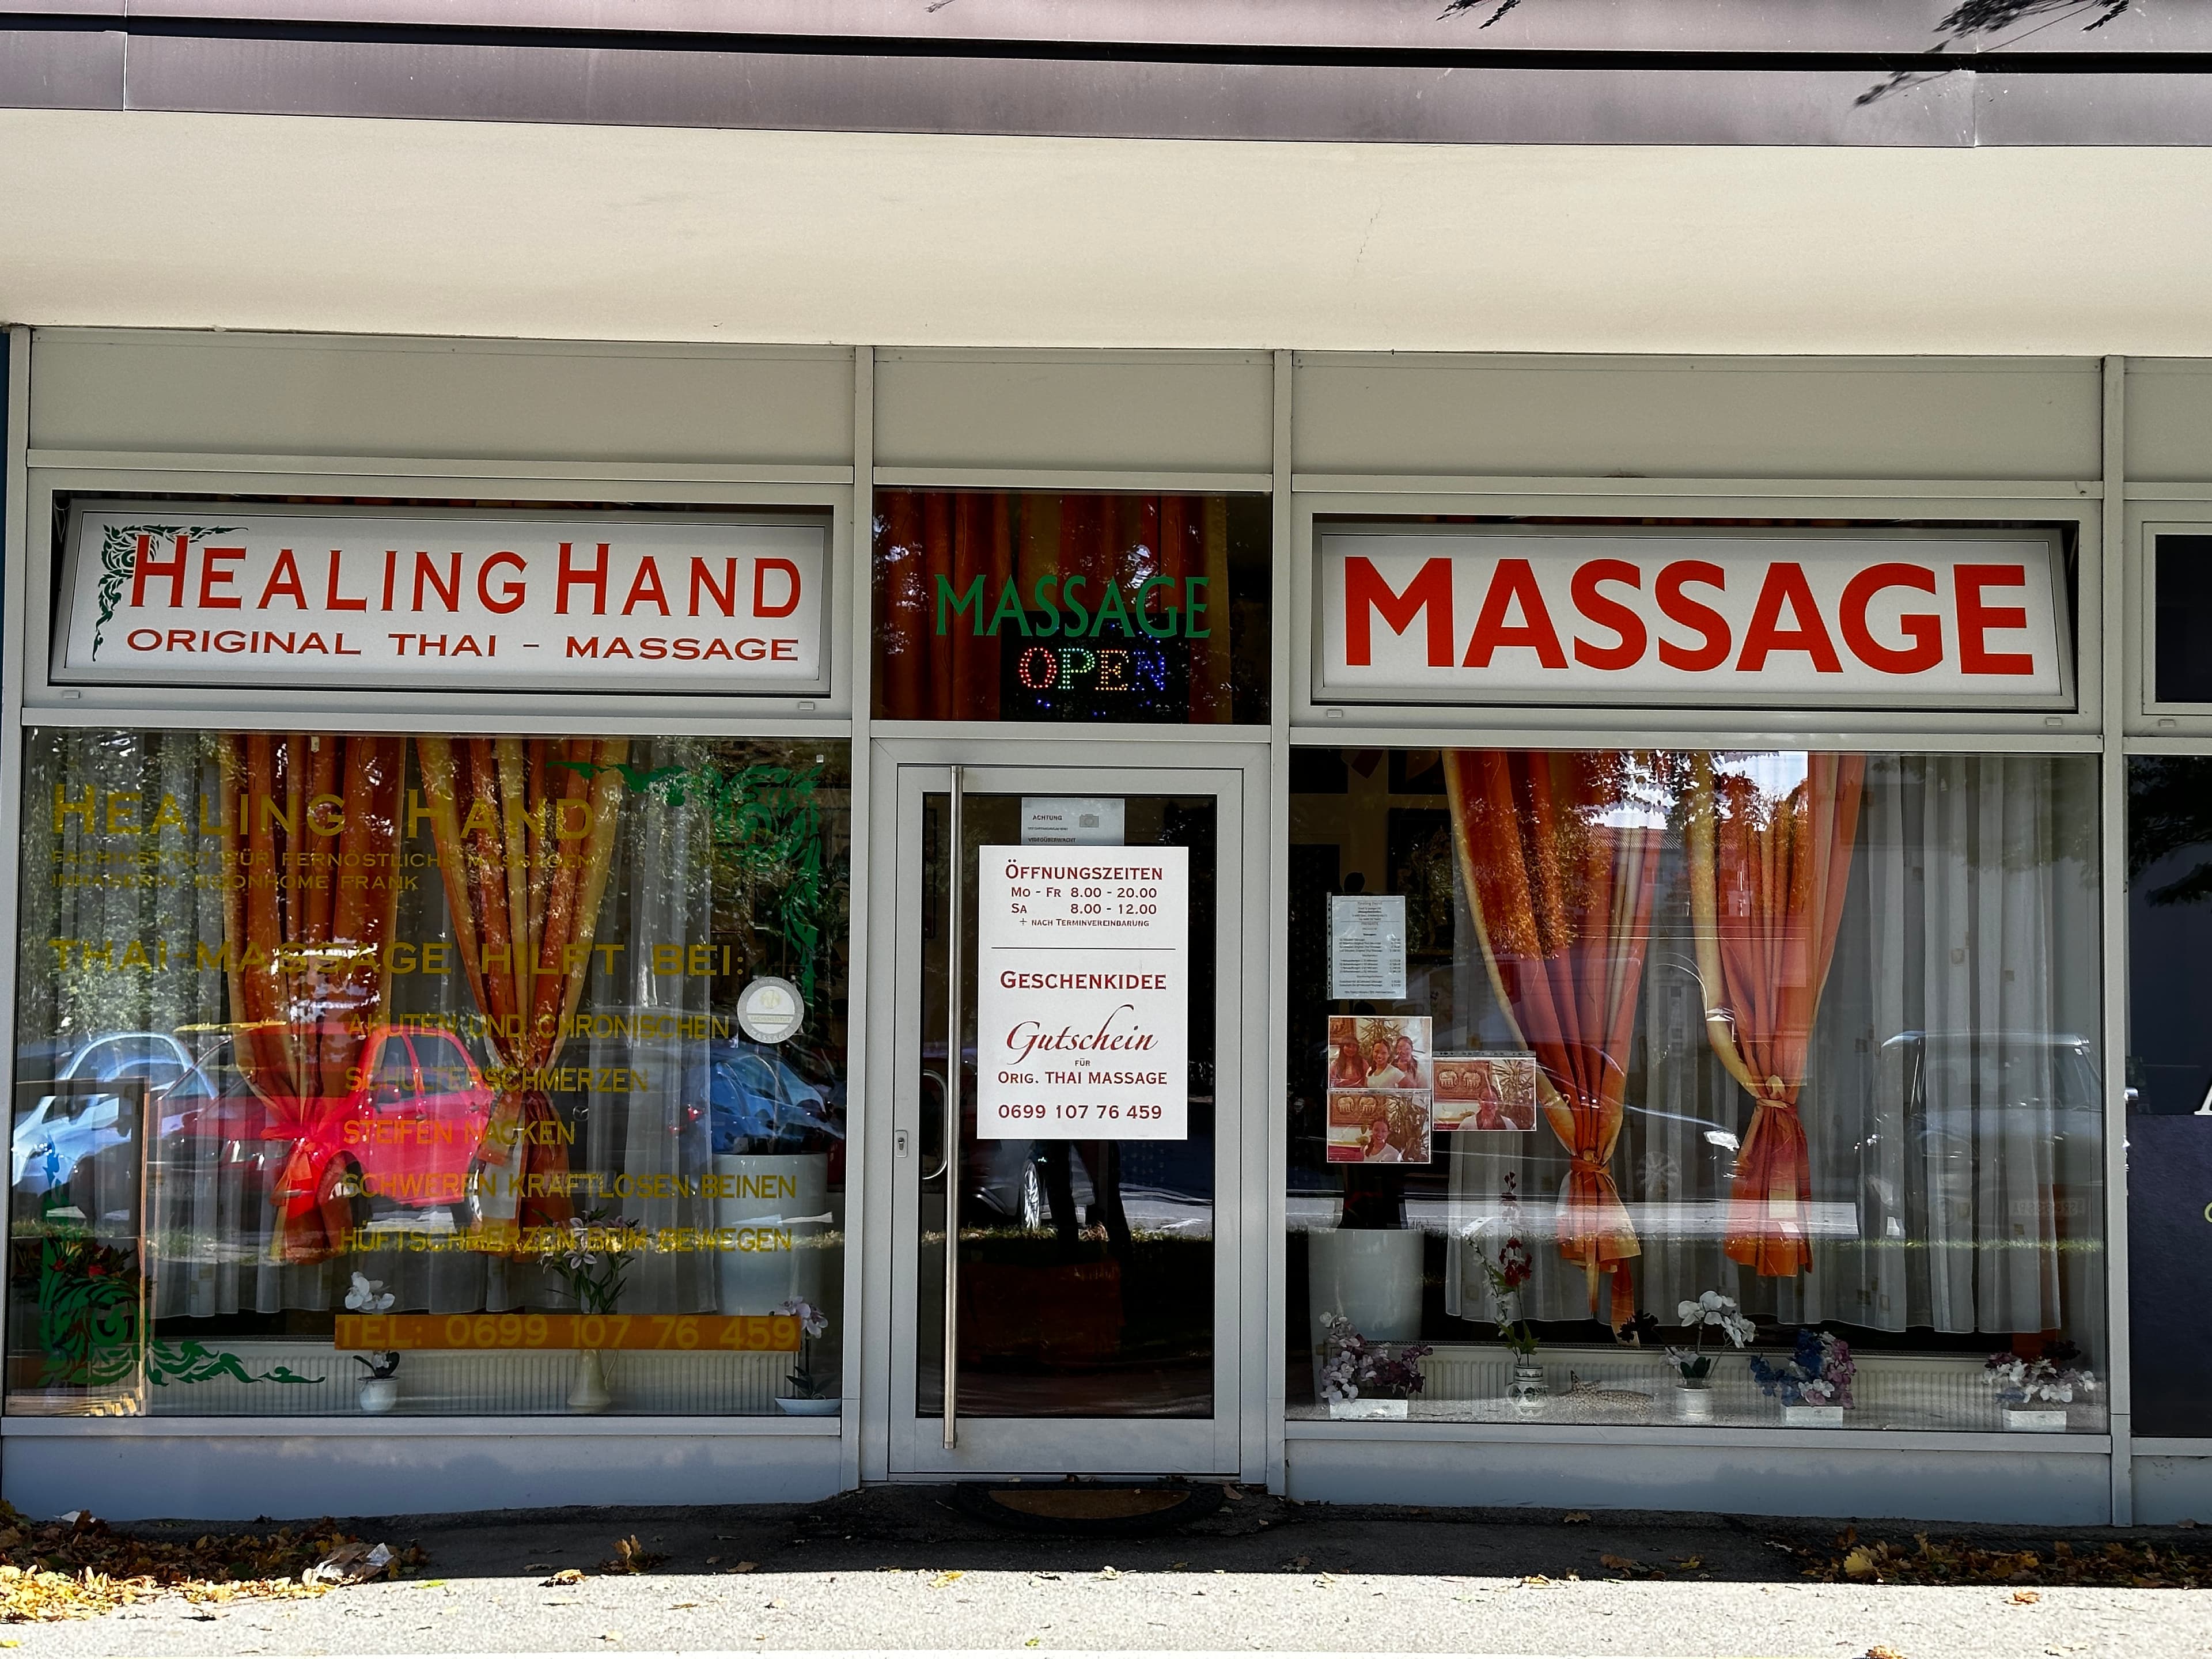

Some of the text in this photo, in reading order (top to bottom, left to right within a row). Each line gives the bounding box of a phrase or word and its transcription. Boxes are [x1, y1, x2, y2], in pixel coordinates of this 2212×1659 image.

[130, 533, 801, 618] HEALING HAND
[934, 574, 1211, 638] MASSAGE
[1344, 556, 2035, 675] MASSAGE
[127, 628, 362, 656] ORIGINAL
[388, 632, 497, 657] THAI
[566, 636, 799, 661] MASSAGE
[1020, 646, 1166, 691] OPEN
[54, 784, 593, 840] HEALING HAND
[341, 875, 419, 890] FRANK
[1005, 859, 1162, 880] ÖFFNUNGSZEITEN
[1070, 887, 1101, 898] 8.00
[1117, 887, 1157, 898] 20.00
[1070, 903, 1101, 914] 8.00
[1118, 904, 1157, 915] 12.00
[482, 942, 624, 975] HILFT
[652, 944, 744, 976] BEI:
[1001, 971, 1166, 990] GESCHENKIDEE
[348, 1013, 729, 1039] AKUTEN UND CHRONISCHEN
[1006, 1004, 1158, 1065] Gutschein
[1075, 1058, 1090, 1066] FÜR
[346, 1066, 649, 1093] SCHULTERSCHMERZEN
[1046, 1071, 1081, 1084] THAI
[1089, 1072, 1167, 1085] MASSAGE
[998, 1104, 1162, 1119] 0699 107 76 459
[344, 1119, 575, 1145] STEIFEN NACKEN
[343, 1173, 796, 1199] SCHWEREN KRAFTLOSEN BEINEN
[340, 1219, 793, 1253] HÜFTSCHMERZEN BEIM BEWEGEN
[335, 1314, 797, 1351] TEL: 0699 107 76 459
